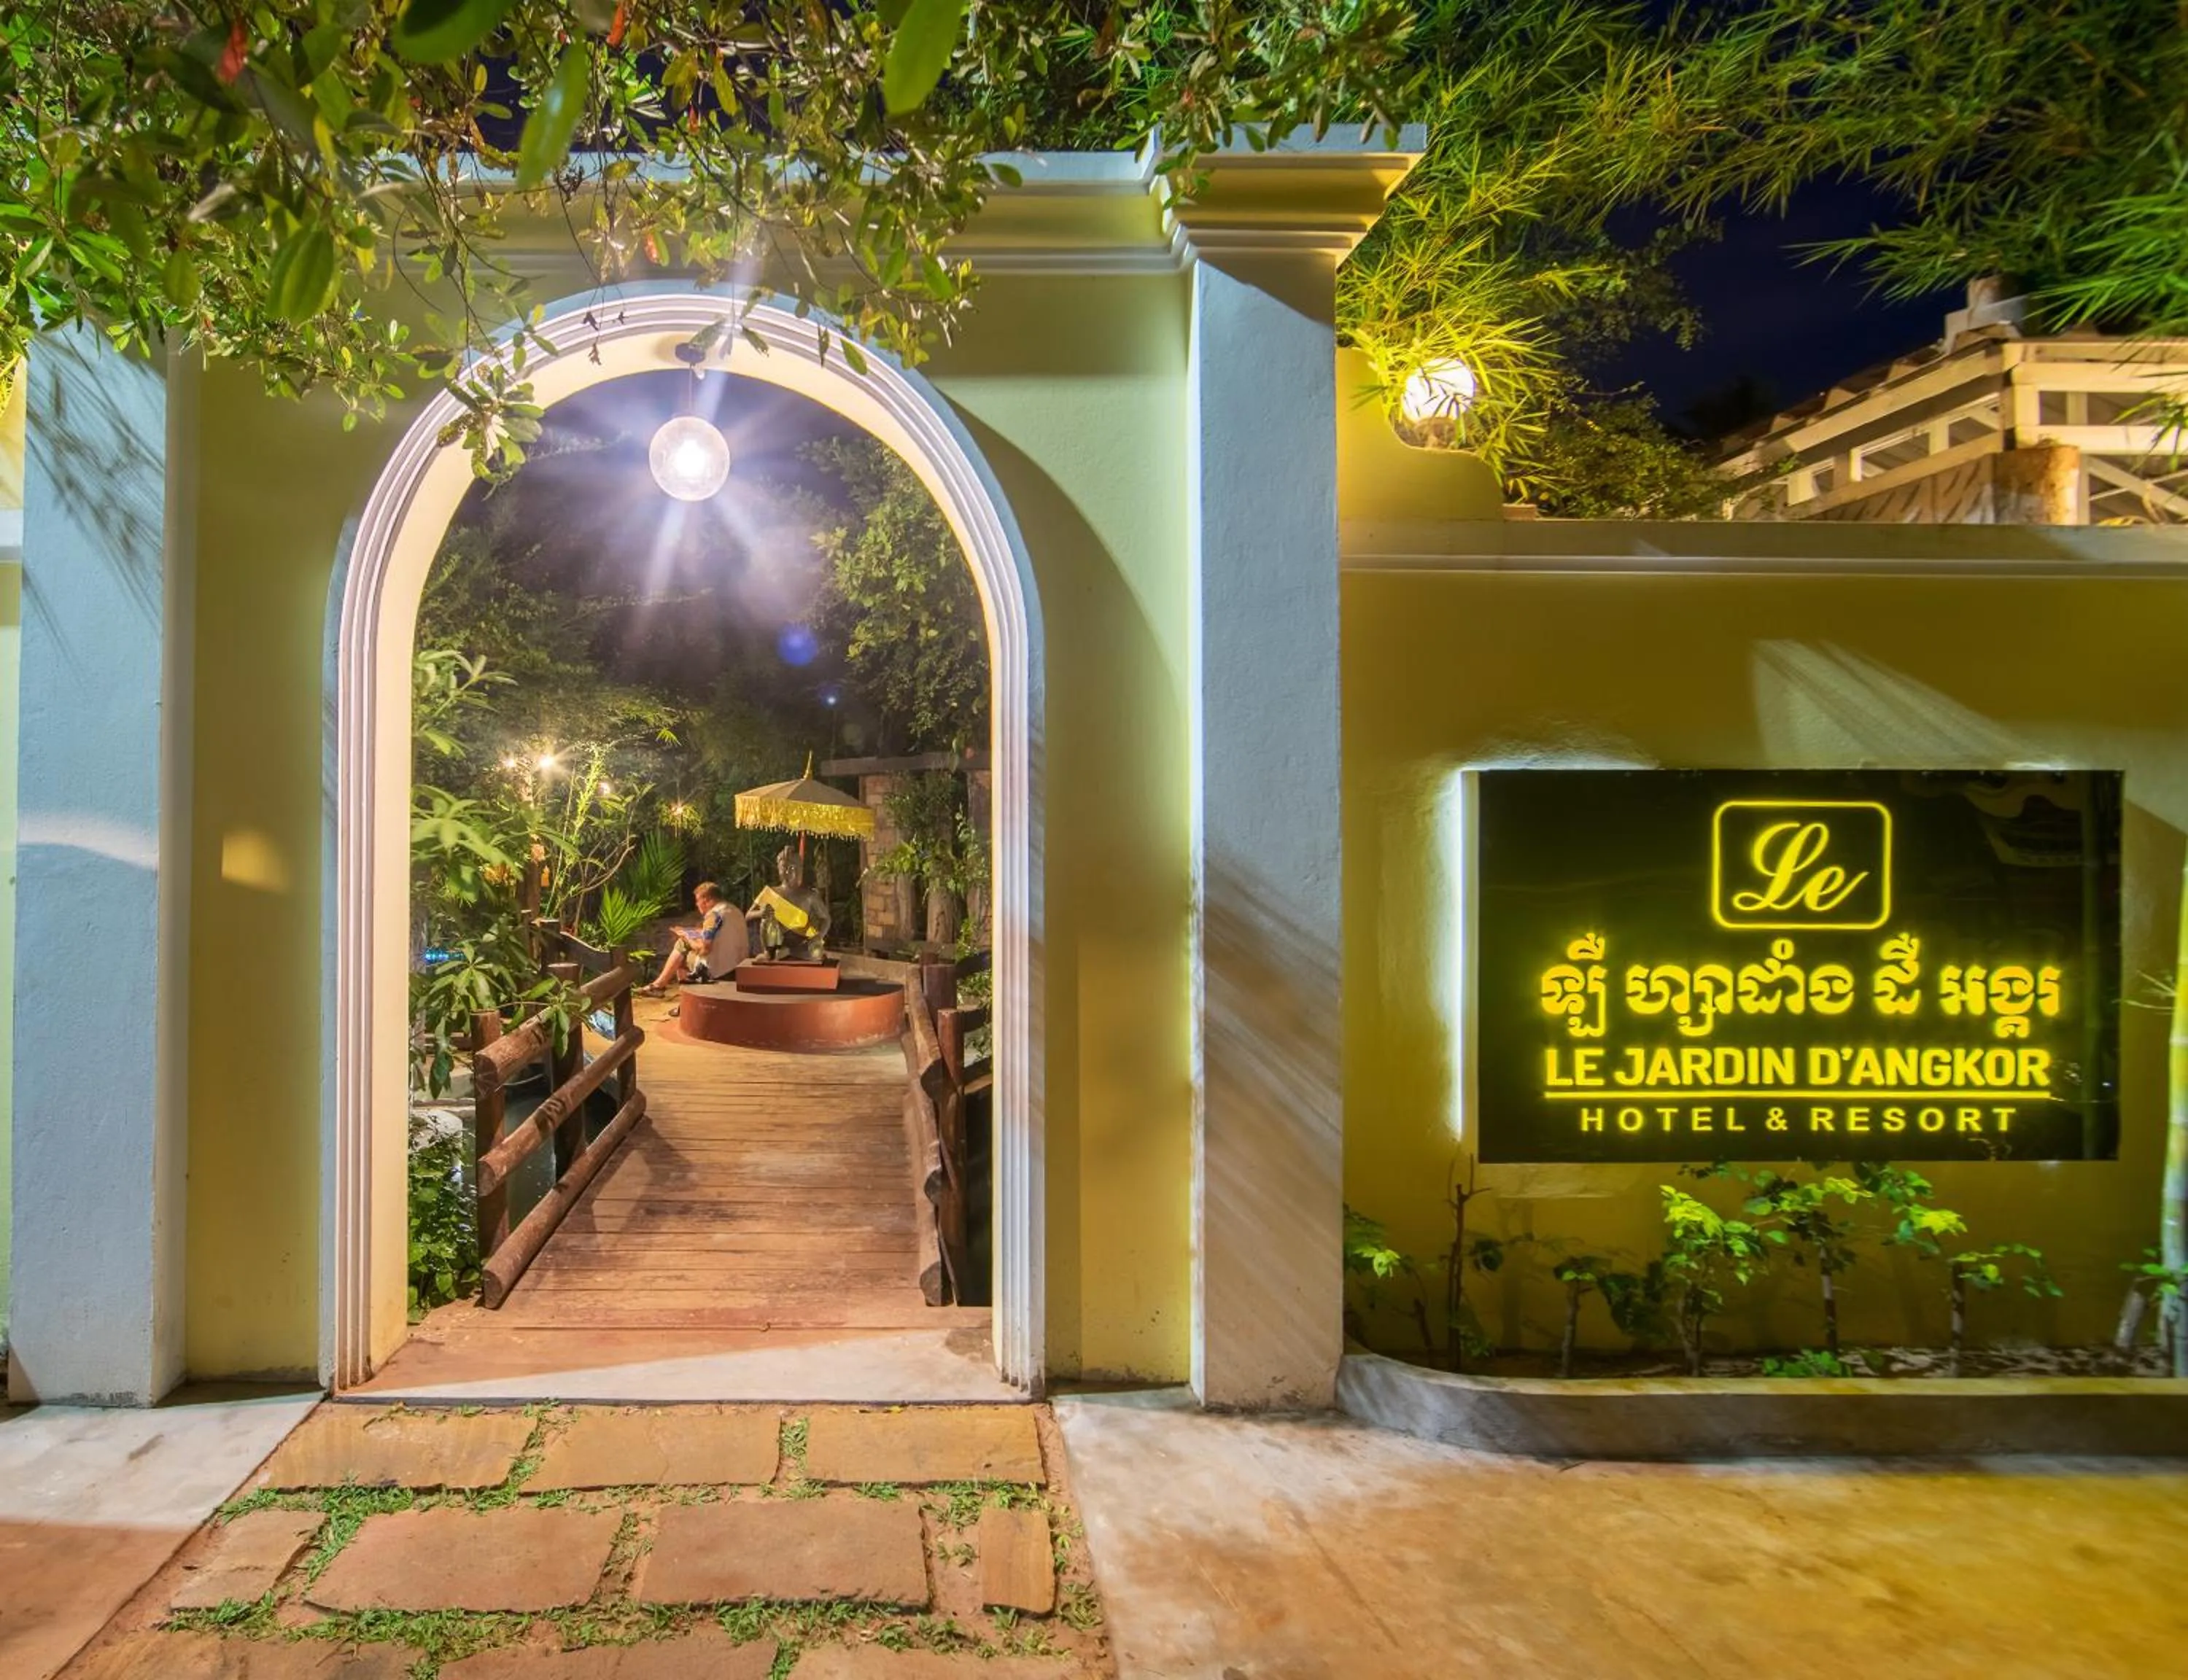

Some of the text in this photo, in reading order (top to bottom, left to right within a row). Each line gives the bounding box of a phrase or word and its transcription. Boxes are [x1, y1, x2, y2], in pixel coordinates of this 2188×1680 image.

[1732, 822, 1868, 911] Le
[1939, 965, 2061, 1038] អង្គរ
[1545, 1046, 2051, 1086] LE JARDIN D’ANGKOR
[1581, 1107, 2016, 1132] HOTEL & RESORT
